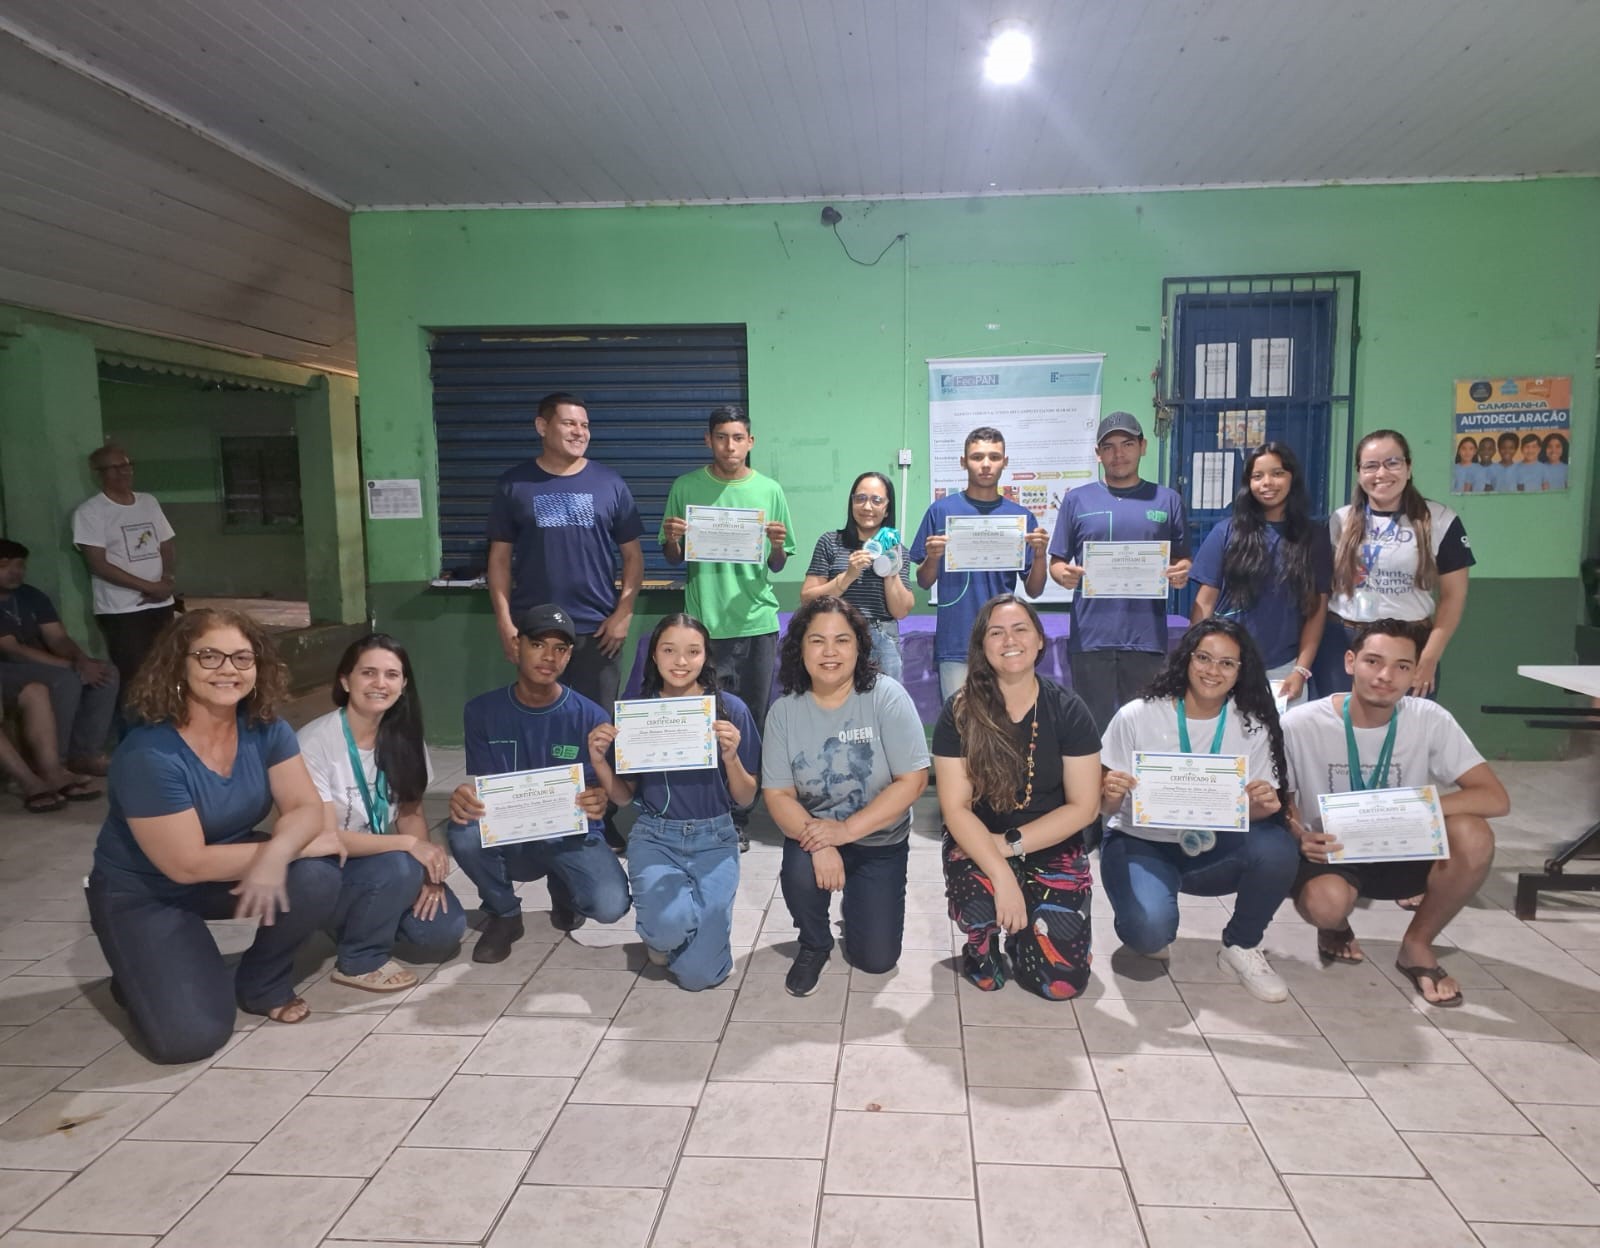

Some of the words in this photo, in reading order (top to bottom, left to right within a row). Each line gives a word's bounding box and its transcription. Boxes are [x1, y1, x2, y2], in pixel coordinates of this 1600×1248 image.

[1477, 401, 1548, 411] CAMPANHA
[1460, 410, 1567, 426] AUTODECLARAÇÃO
[646, 718, 681, 726] CERTIFICADO
[838, 726, 874, 743] QUEEN
[1170, 775, 1209, 783] CERTIFICADO
[512, 789, 549, 799] CERTIFICADO
